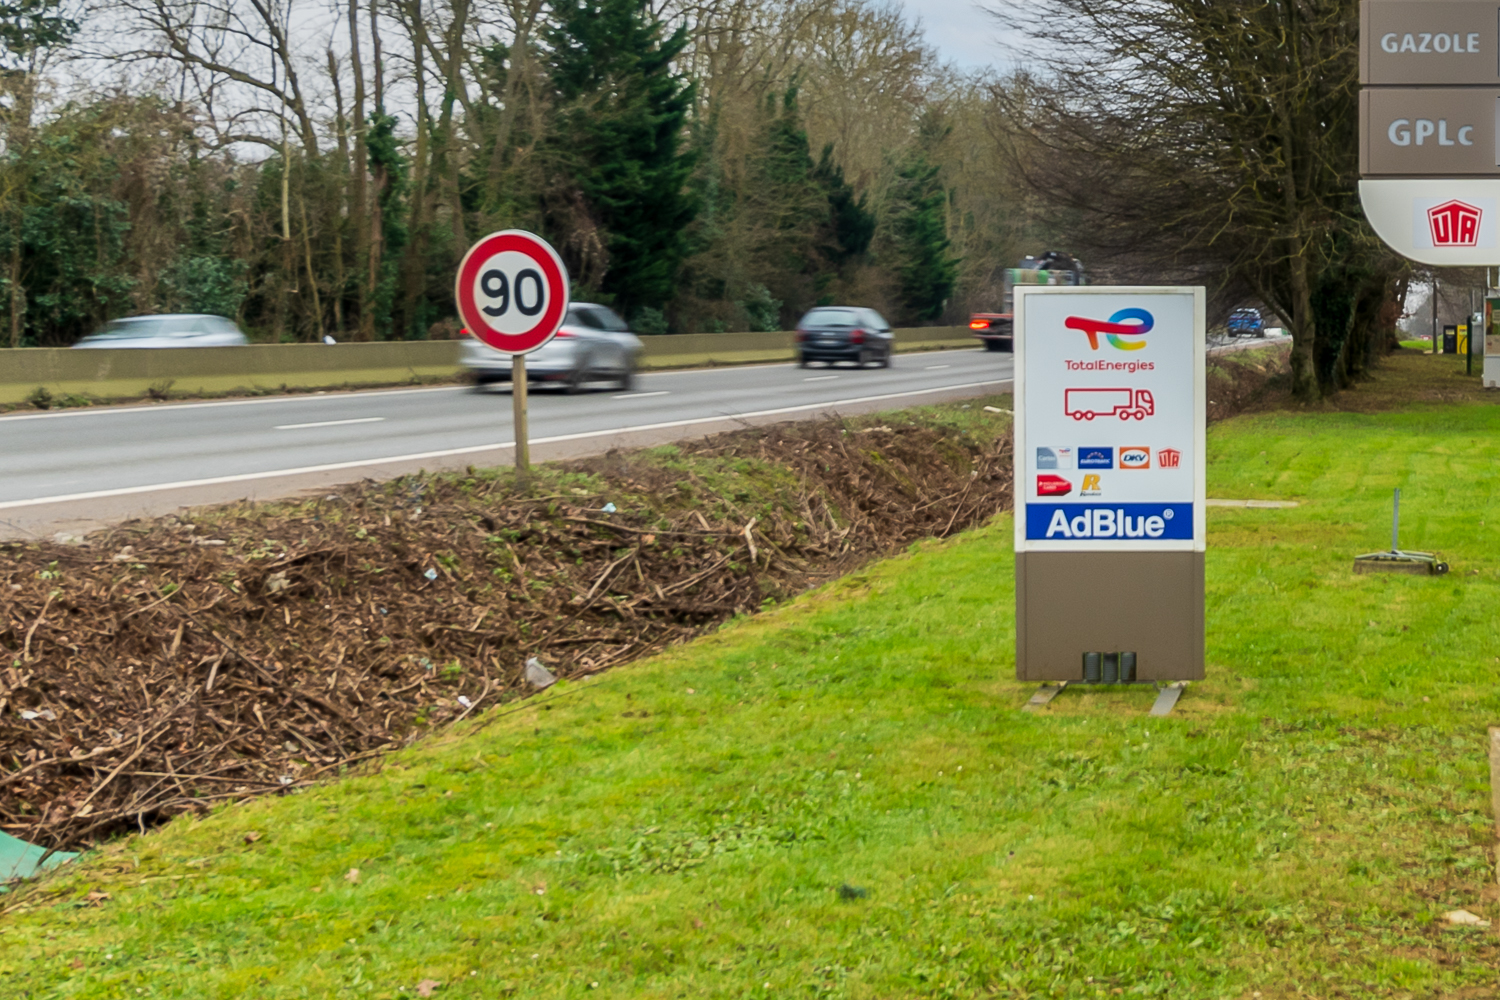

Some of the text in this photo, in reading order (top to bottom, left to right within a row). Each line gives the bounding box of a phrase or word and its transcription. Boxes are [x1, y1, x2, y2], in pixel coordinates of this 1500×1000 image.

[1380, 32, 1480, 53] GAZOLE
[1387, 118, 1474, 147] GPLc
[1428, 200, 1482, 246] UTA
[481, 268, 544, 317] 90
[1065, 360, 1154, 373] TotalEnergies
[1123, 454, 1146, 462] DKV
